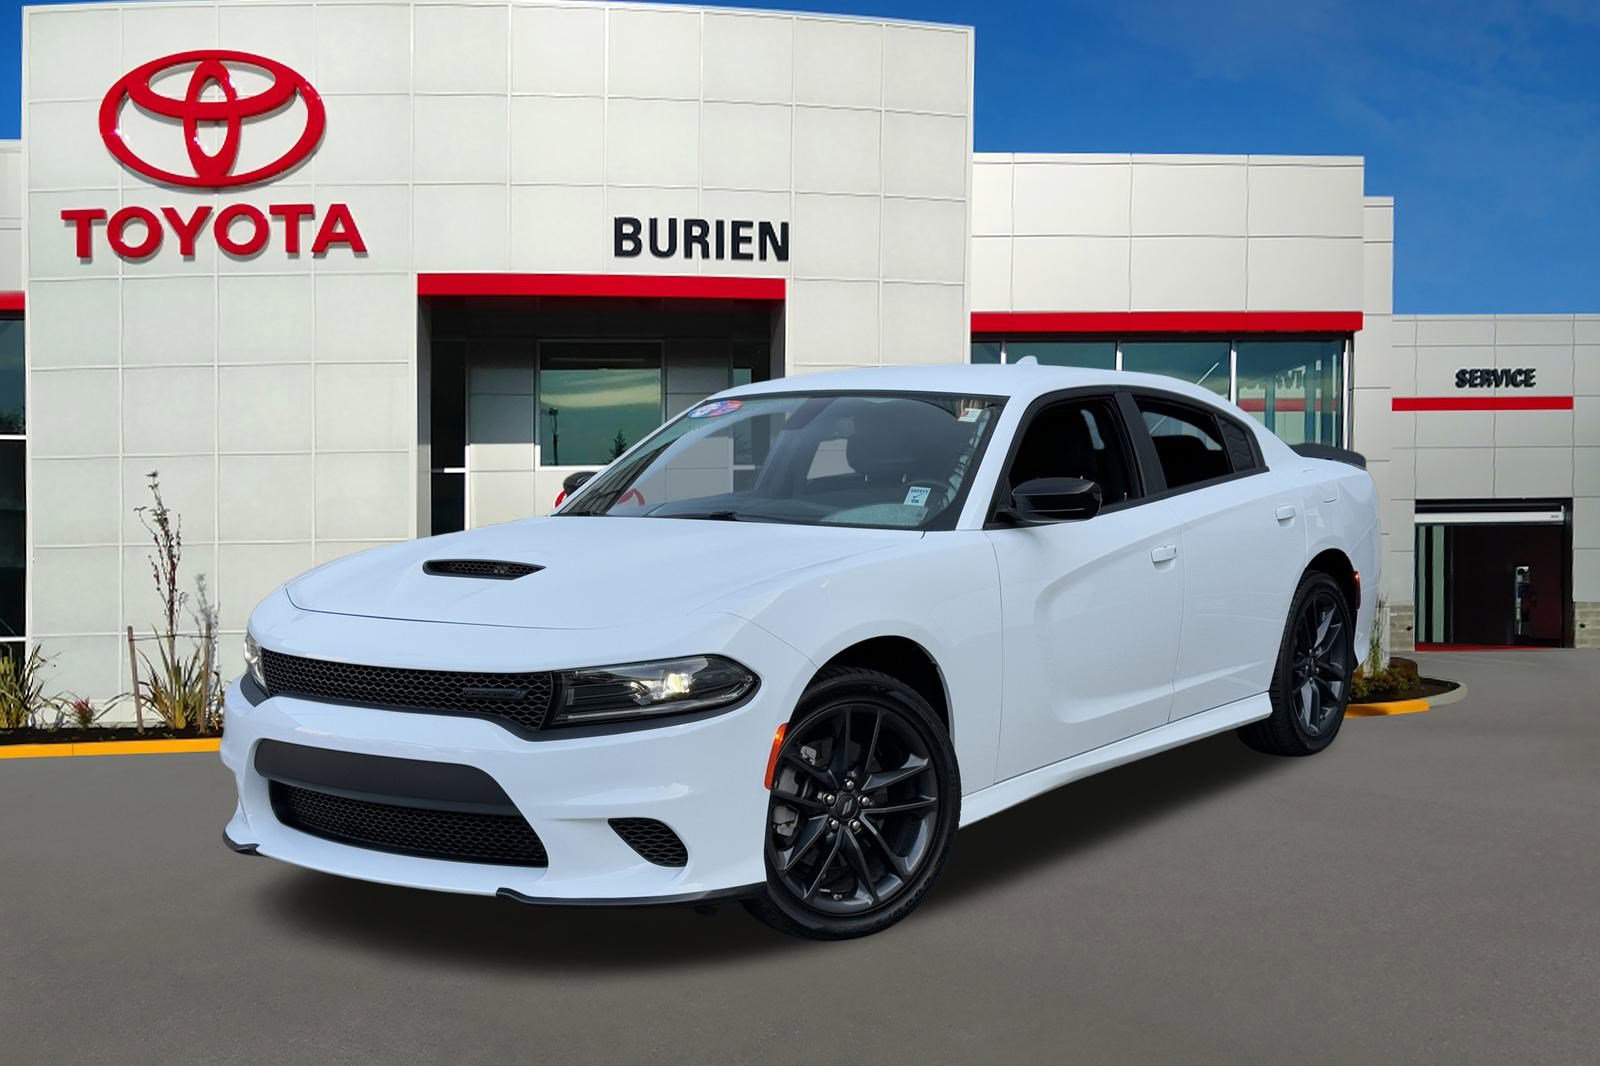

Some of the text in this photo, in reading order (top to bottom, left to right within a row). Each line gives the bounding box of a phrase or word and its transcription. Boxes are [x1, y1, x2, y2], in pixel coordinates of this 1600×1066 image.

[61, 203, 367, 258] TOYOTA
[614, 216, 789, 261] BURIEN
[1455, 368, 1536, 388] SERVICE
